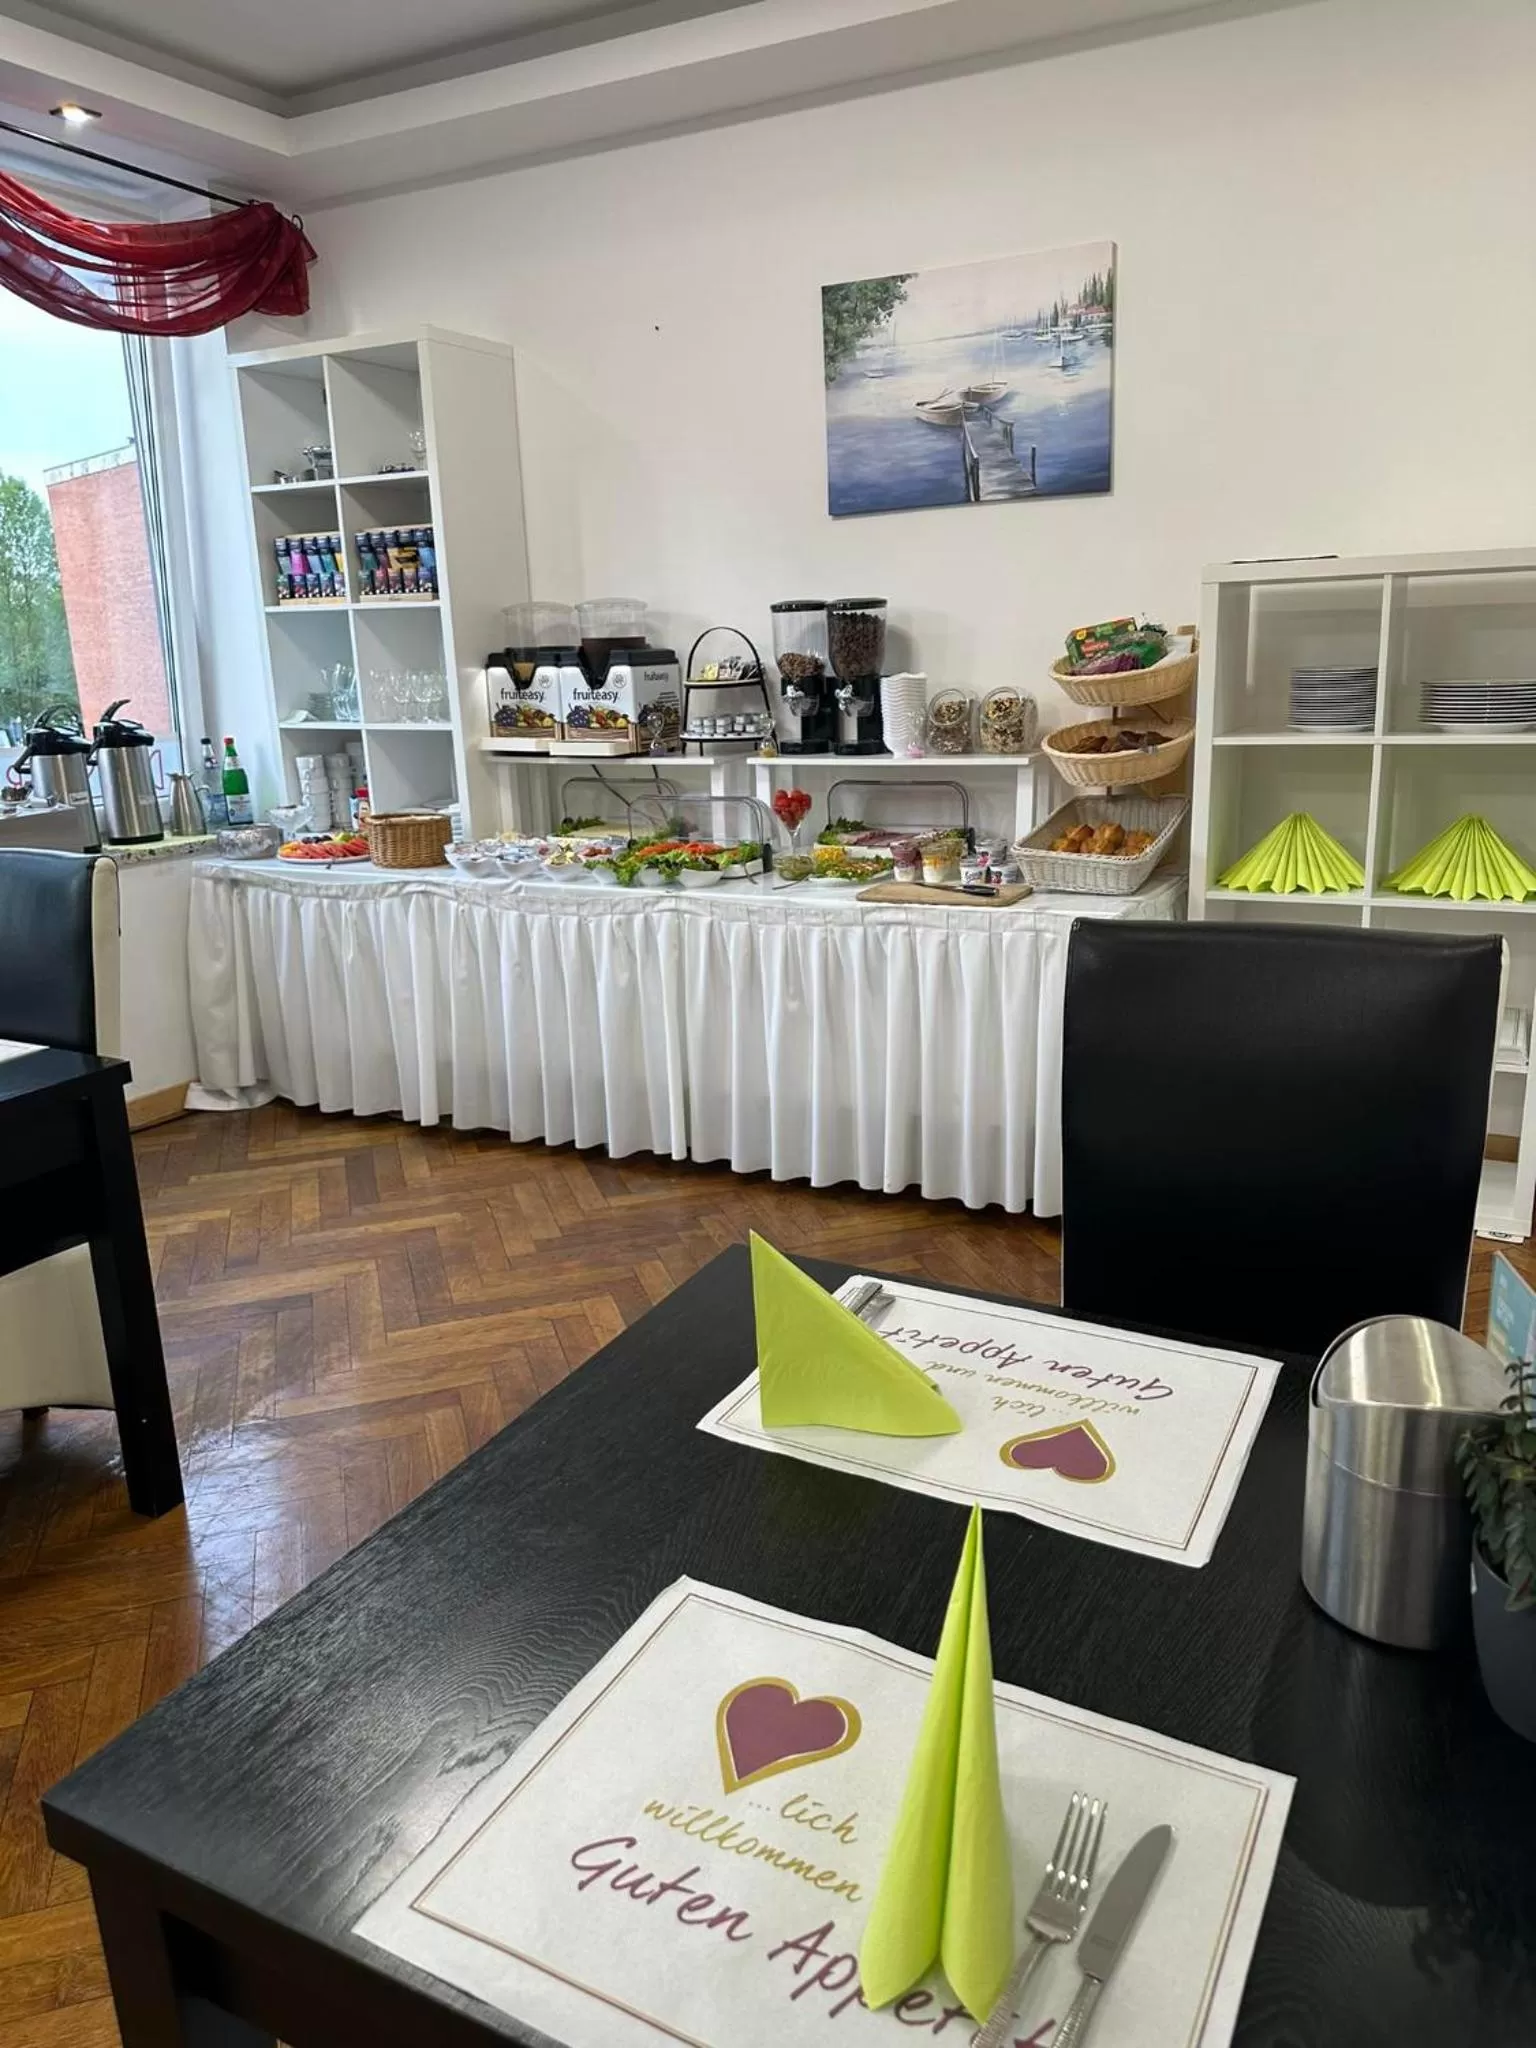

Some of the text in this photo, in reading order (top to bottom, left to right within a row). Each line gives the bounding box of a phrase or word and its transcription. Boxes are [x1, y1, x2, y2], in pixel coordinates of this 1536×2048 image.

[500, 688, 545, 702] fruiteasy
[572, 688, 619, 703] fruiteasy
[879, 1326, 1175, 1401] Guten Appetit
[924, 1360, 1141, 1415] willkommen und
[643, 1800, 863, 1903] willkommen
[571, 1836, 754, 1942] Guten
